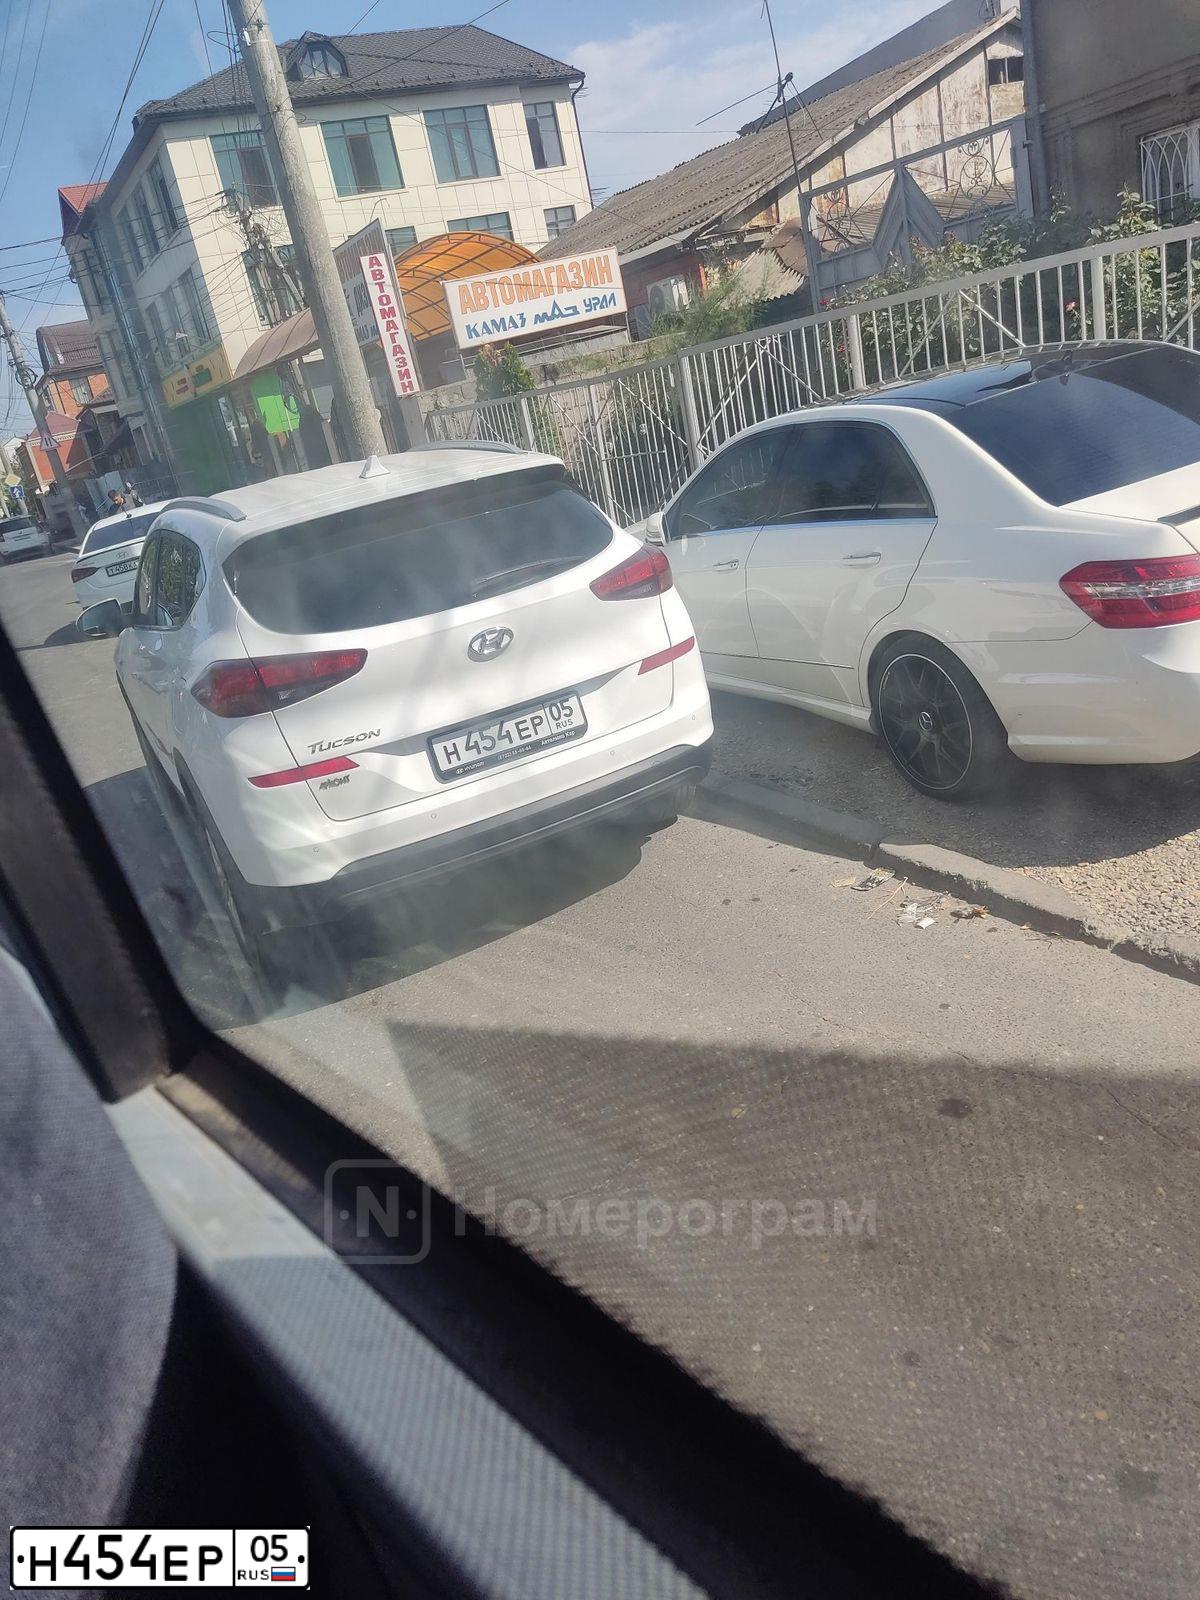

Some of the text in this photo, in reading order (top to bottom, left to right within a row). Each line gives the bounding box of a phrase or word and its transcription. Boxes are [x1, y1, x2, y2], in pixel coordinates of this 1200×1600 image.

[457, 255, 613, 315] АВТОМАГАЗИН
[368, 255, 414, 393] АВТОМАГАЗИН
[466, 312, 526, 340] КАМАЗ
[583, 292, 616, 313] УРАЛ
[549, 698, 574, 721] 05
[555, 719, 574, 729] RUS
[307, 728, 381, 755] TUCSON
